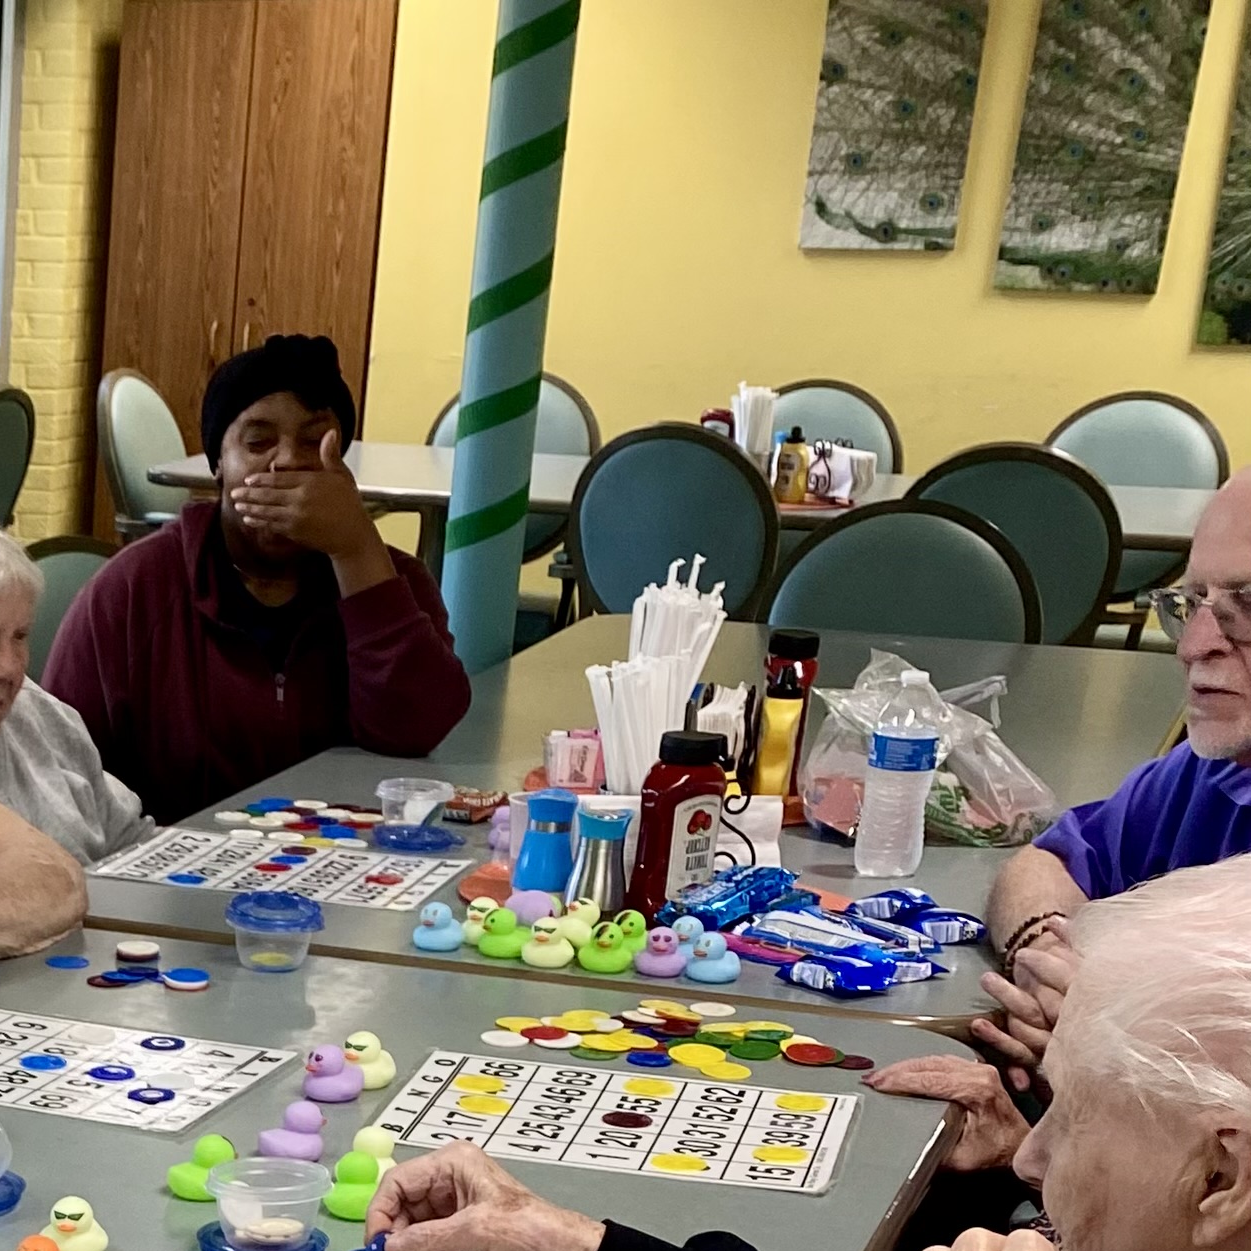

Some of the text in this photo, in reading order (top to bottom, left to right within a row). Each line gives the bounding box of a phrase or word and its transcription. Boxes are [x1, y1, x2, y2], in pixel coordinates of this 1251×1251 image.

[12, 1021, 48, 1031] 6
[508, 1070, 597, 1153] 4 25 43 46 69
[616, 1095, 662, 1113] 55
[673, 1087, 747, 1157] 30 31 52 62
[595, 1130, 643, 1149] 20
[745, 1112, 817, 1181] 15 39 59
